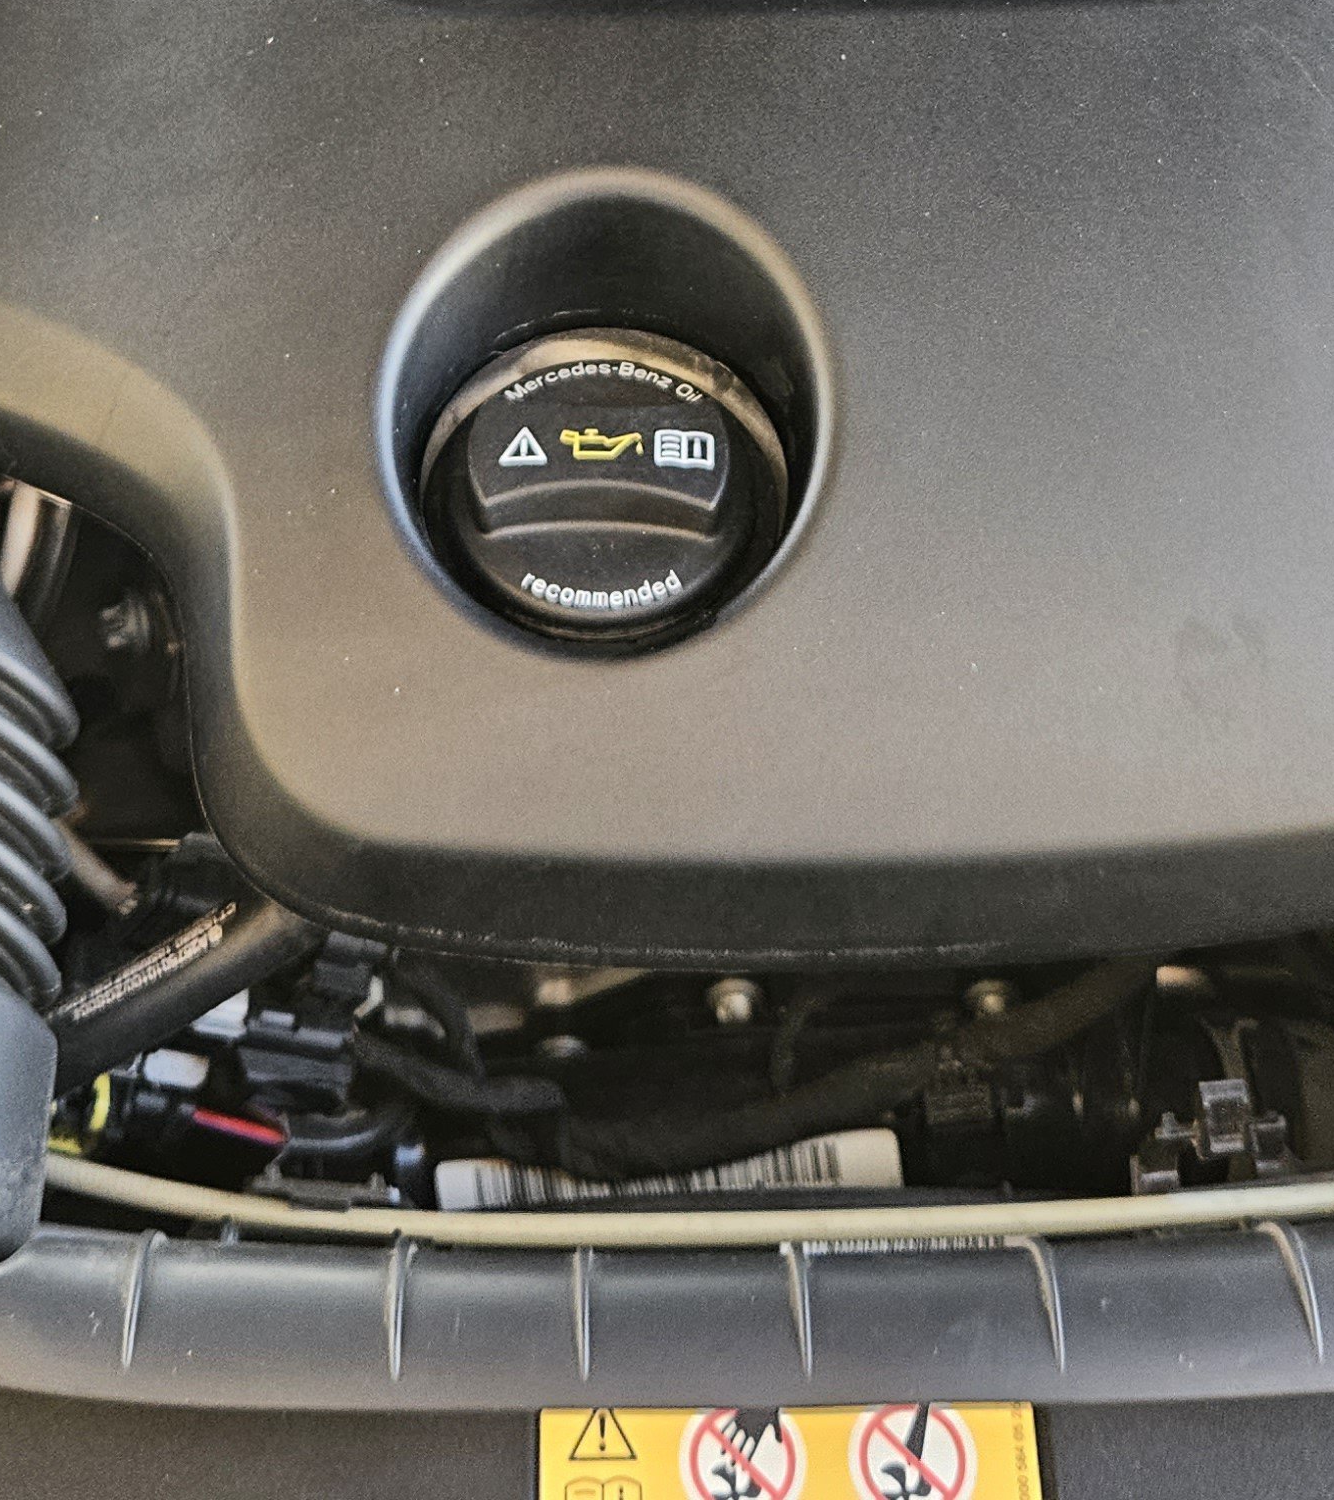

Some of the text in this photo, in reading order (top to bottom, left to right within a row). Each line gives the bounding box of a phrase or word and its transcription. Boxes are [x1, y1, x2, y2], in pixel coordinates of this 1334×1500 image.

[504, 361, 703, 402] Mercedes-Benz Oil
[521, 570, 683, 609] recommended
